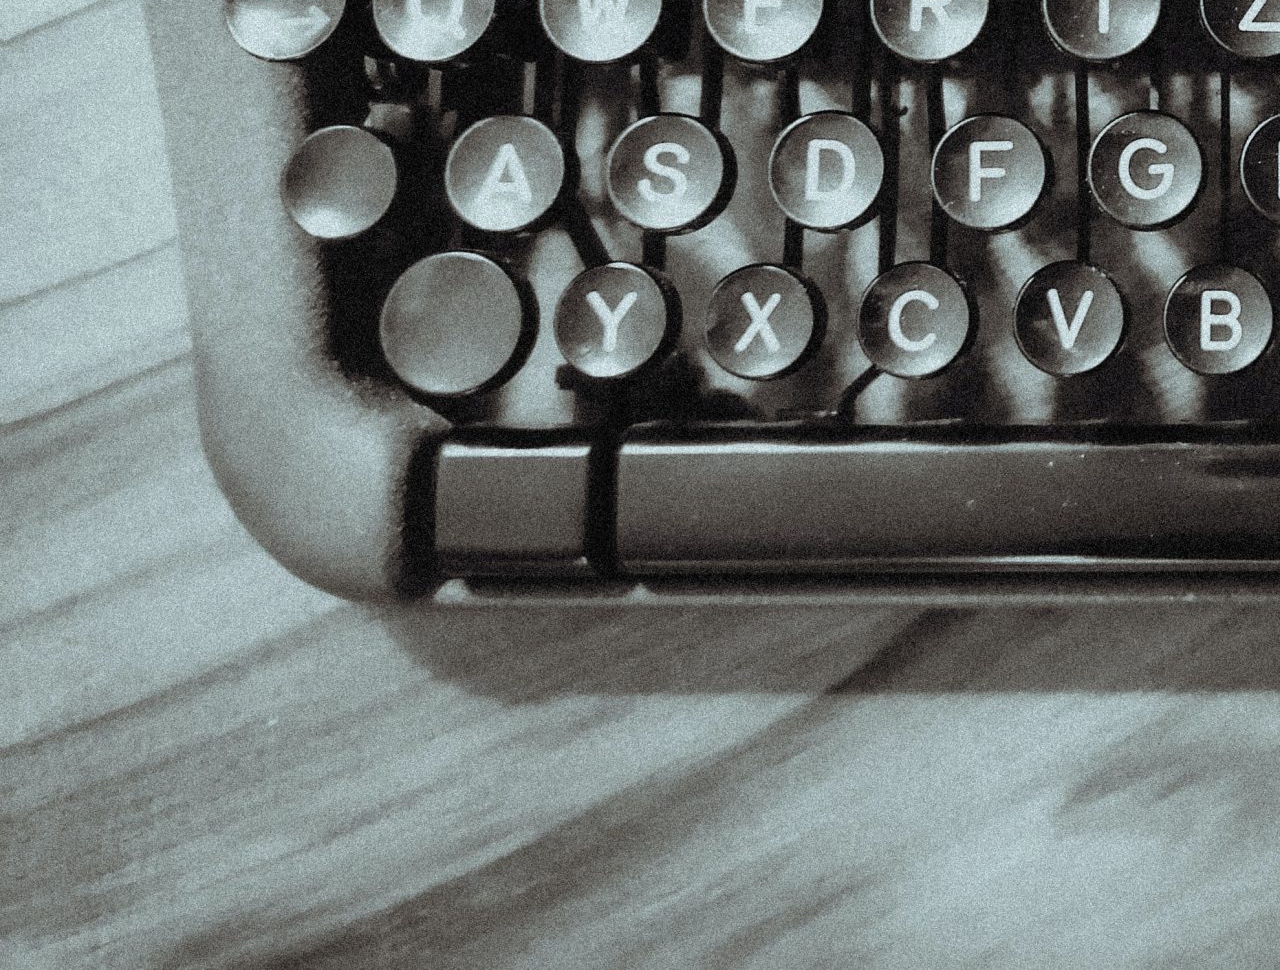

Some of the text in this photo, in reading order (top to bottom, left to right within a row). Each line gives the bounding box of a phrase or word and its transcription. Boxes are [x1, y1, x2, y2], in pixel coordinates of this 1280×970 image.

[472, 142, 533, 204] A
[636, 141, 691, 203] S
[804, 138, 856, 202] D
[969, 139, 1014, 203] F
[1117, 137, 1175, 201] G
[585, 290, 639, 353] Y
[733, 291, 782, 353] X
[887, 289, 940, 352] C
[1046, 288, 1095, 350] V
[1199, 289, 1243, 352] B
